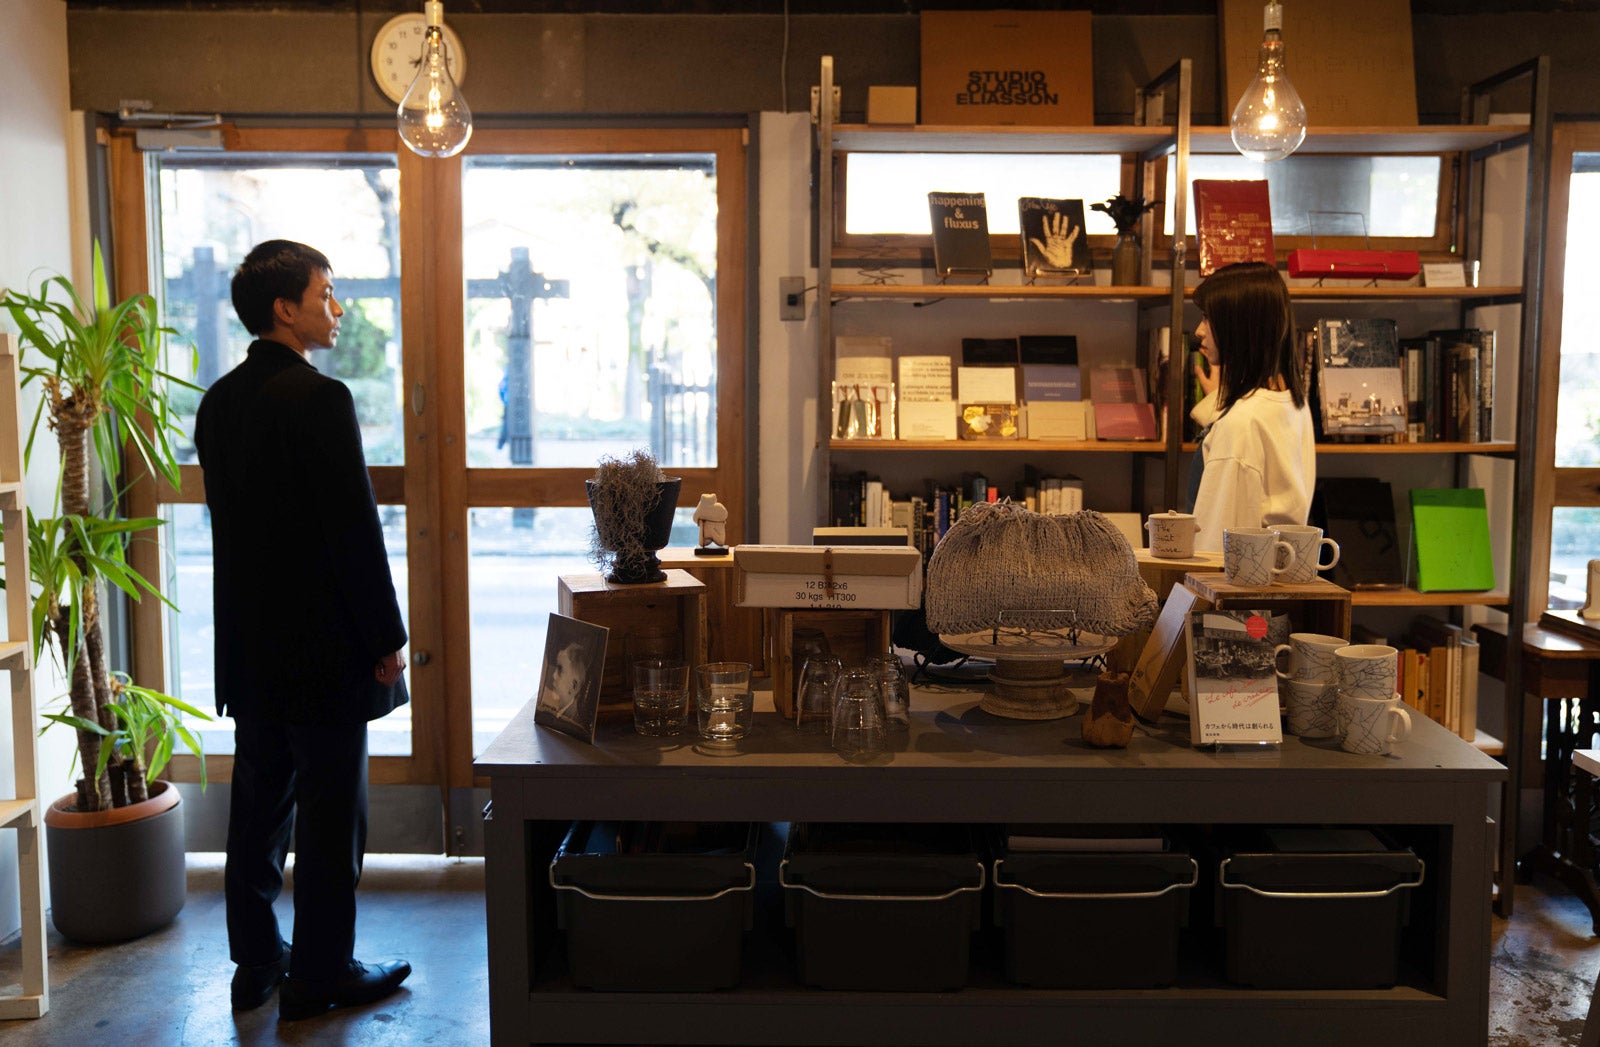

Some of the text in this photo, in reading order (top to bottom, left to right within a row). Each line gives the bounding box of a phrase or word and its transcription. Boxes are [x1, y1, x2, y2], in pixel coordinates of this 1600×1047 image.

[968, 71, 1045, 83] STUDIO
[966, 81, 1047, 94] OLAFUR
[956, 92, 1058, 105] ELIASSON
[931, 195, 985, 208] happening
[954, 207, 964, 219] &
[944, 217, 979, 229] fluxus
[806, 581, 816, 589] 12
[795, 592, 806, 600] 30
[808, 592, 823, 602] kgs
